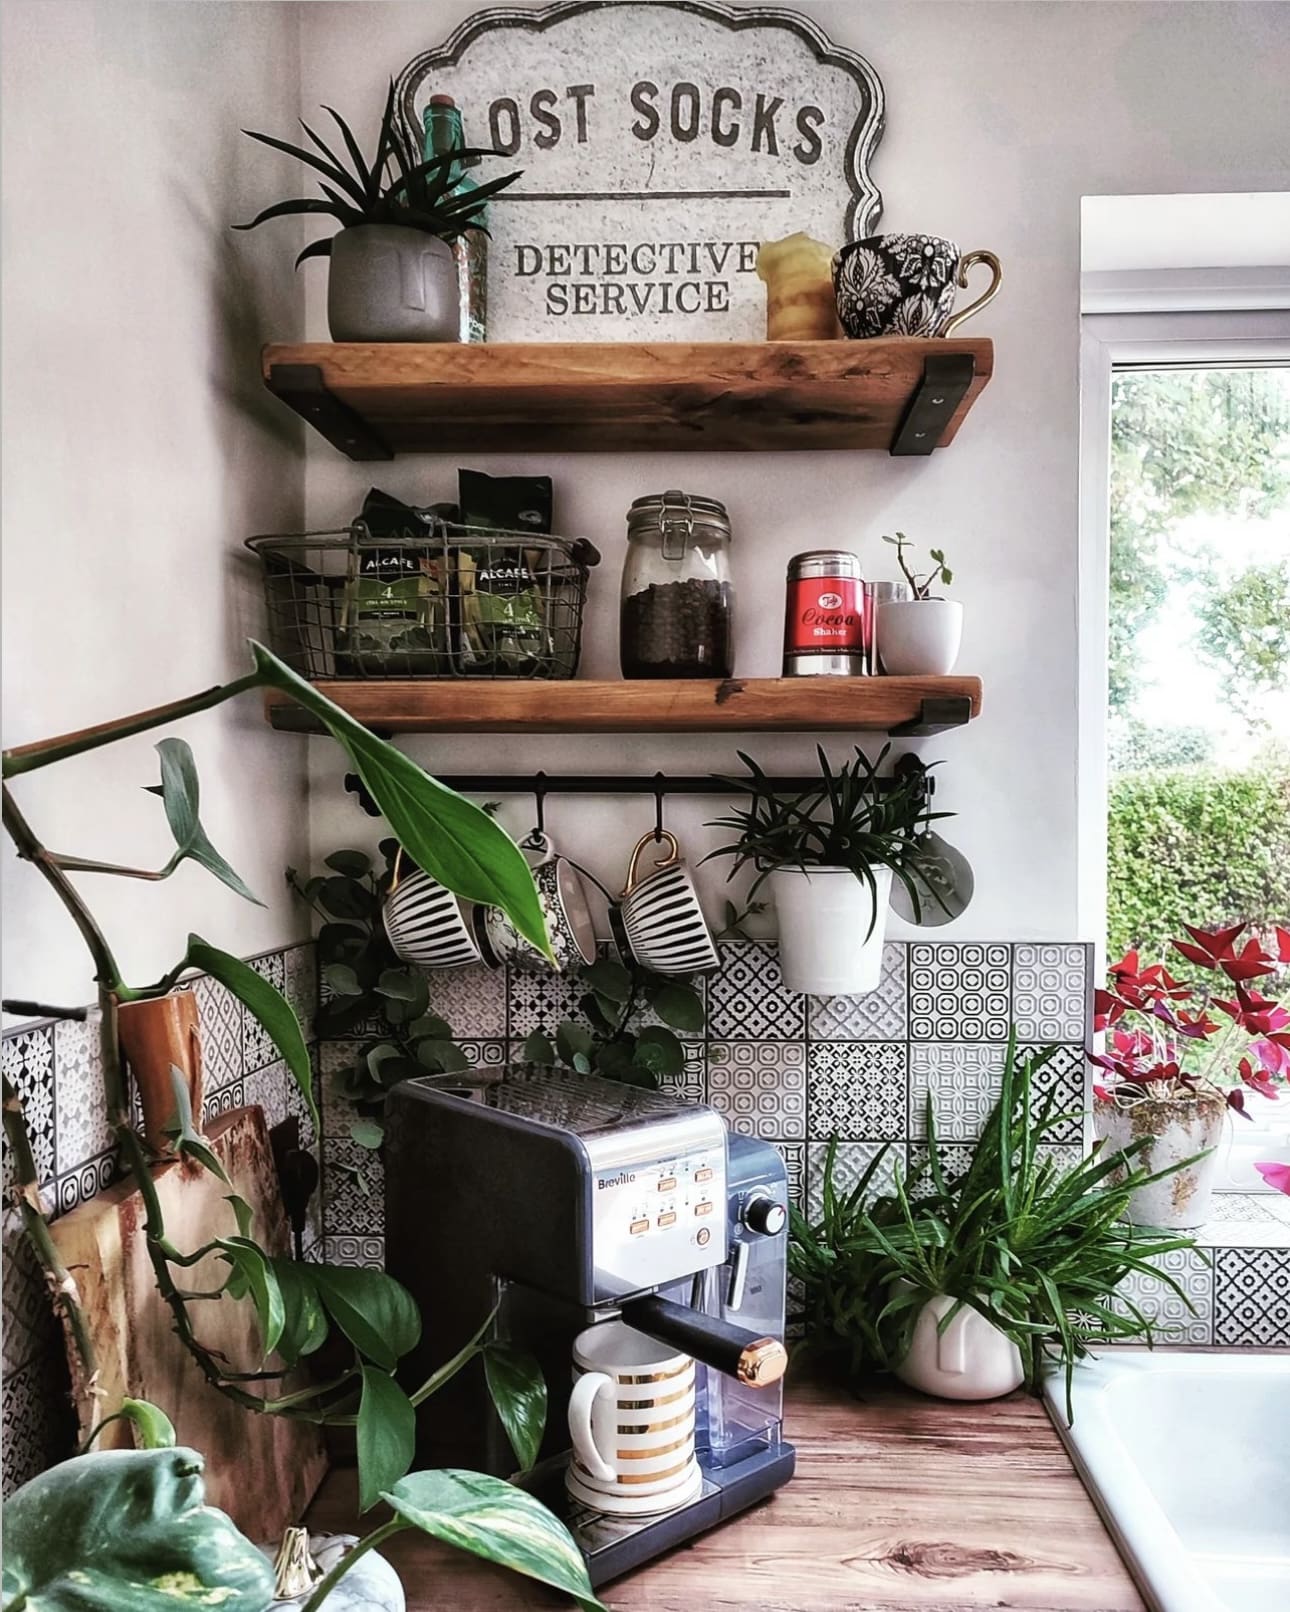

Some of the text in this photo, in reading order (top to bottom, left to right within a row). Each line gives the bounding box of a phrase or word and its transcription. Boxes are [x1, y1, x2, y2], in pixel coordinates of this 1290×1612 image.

[461, 81, 826, 169] OST SOCKS
[514, 241, 760, 276] DETECTIVE
[546, 281, 730, 316] SERVICE
[381, 586, 394, 599] 4
[503, 602, 514, 617] 4
[801, 608, 855, 626] Cocoa
[813, 626, 847, 637] Shaker
[598, 1171, 636, 1190] Breville
